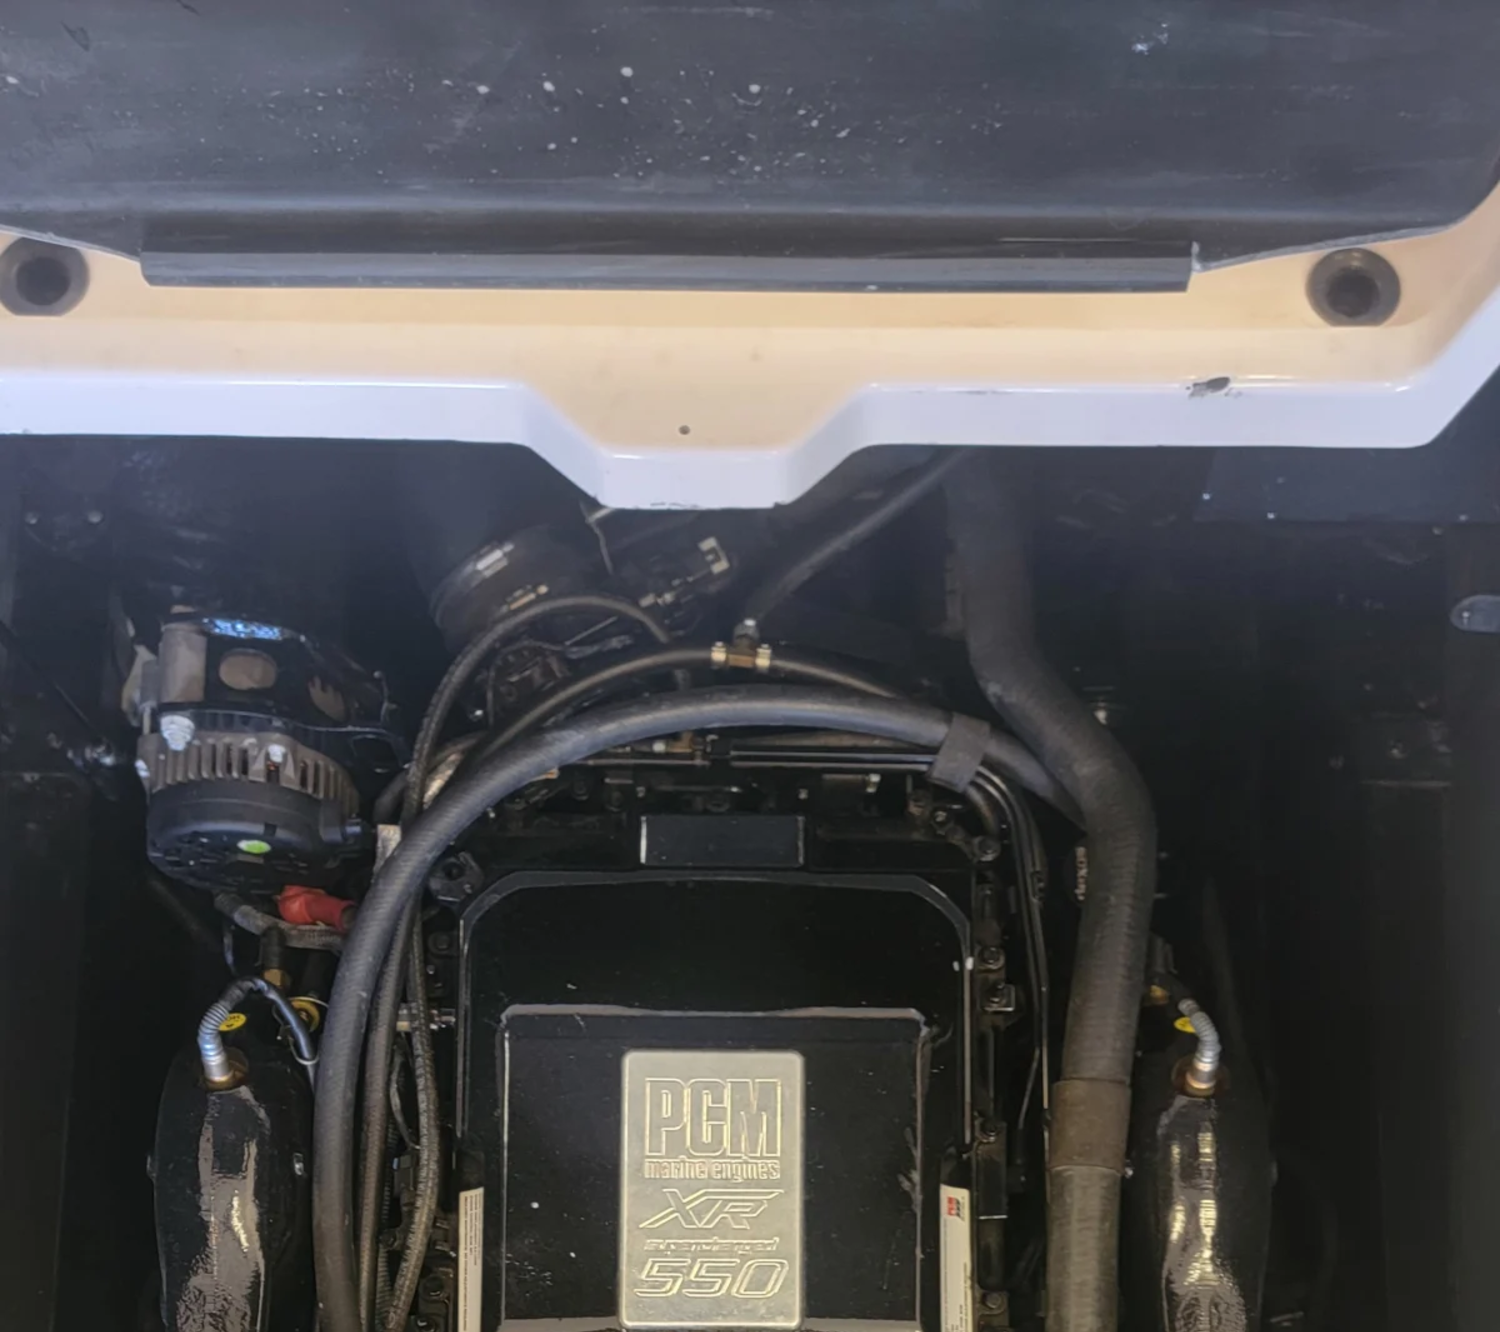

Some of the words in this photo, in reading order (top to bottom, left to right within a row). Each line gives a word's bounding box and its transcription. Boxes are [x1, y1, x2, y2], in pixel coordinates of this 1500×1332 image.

[645, 1078, 781, 1157] PCM
[644, 1156, 708, 1179] marine
[710, 1157, 781, 1183] engines
[633, 1258, 789, 1298] 550
